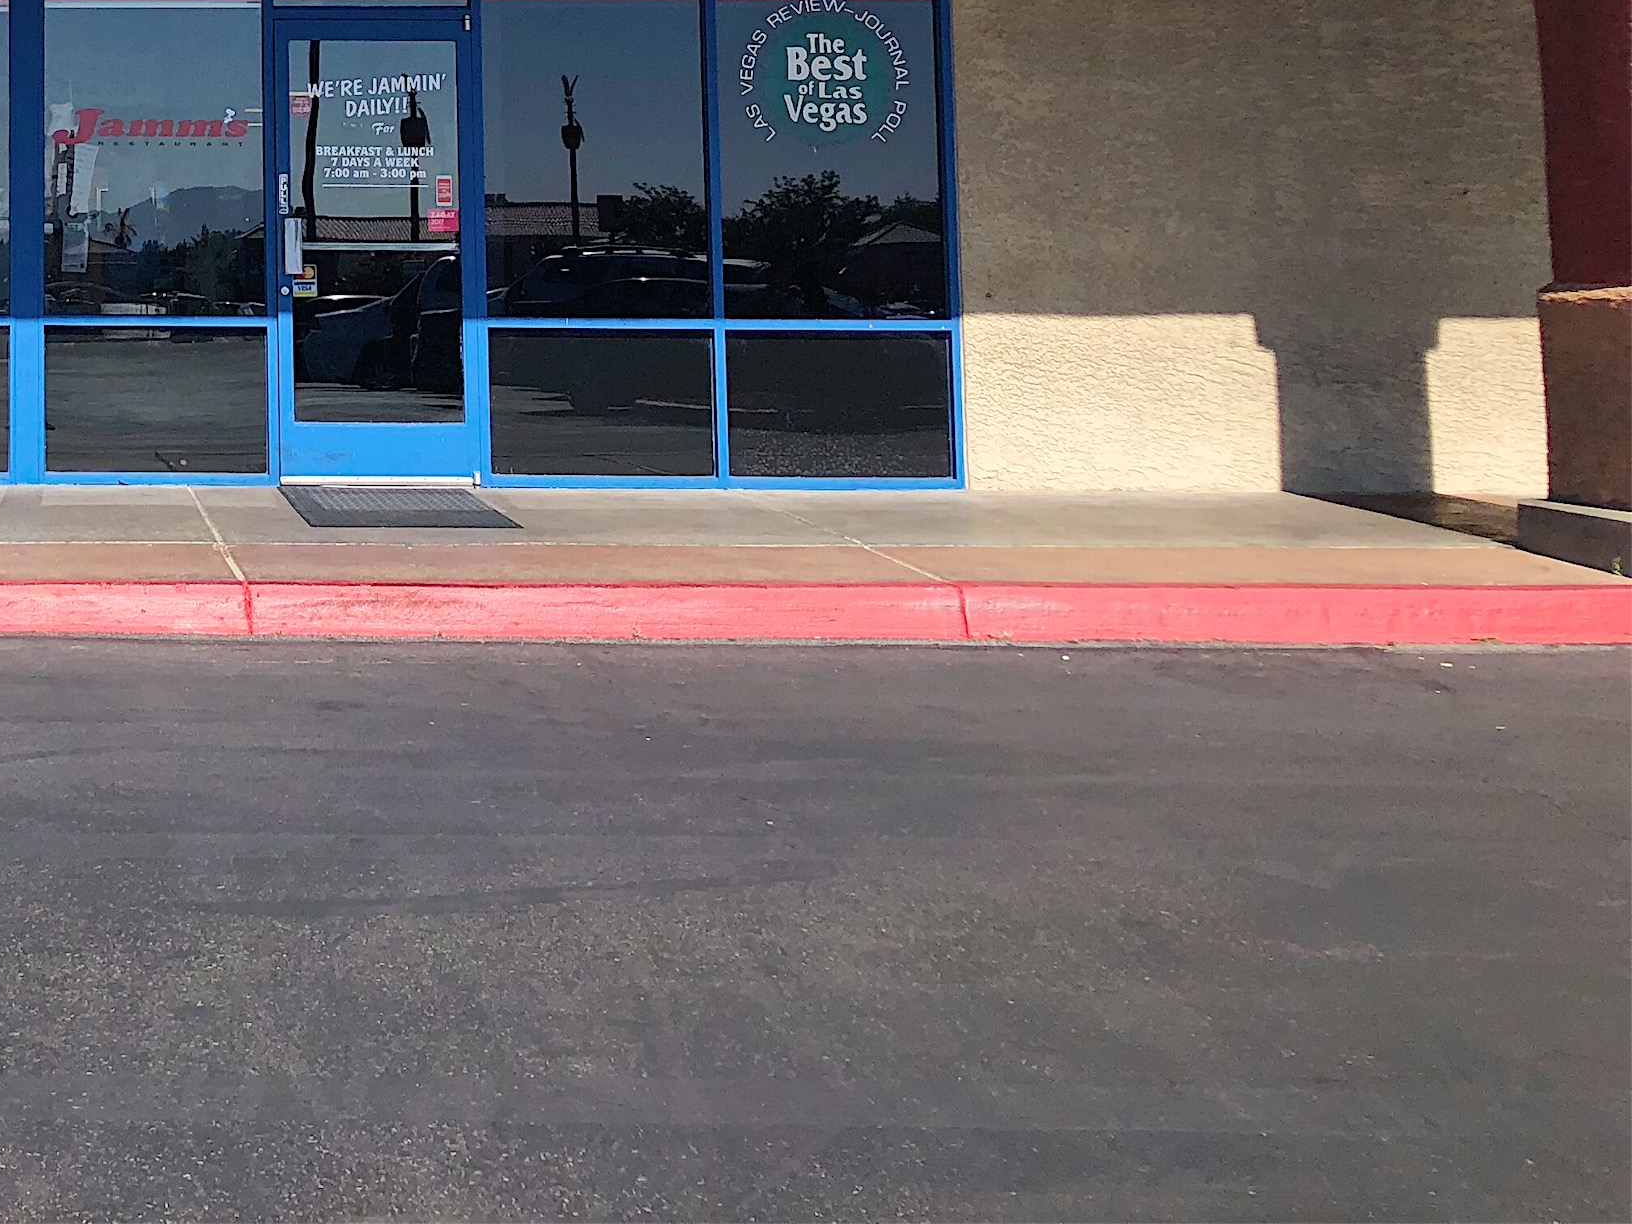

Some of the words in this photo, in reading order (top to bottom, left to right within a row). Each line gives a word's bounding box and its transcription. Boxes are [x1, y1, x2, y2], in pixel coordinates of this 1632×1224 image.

[806, 32, 845, 54] The
[740, 29, 768, 96] VEGAS
[786, 46, 867, 81] Best
[307, 79, 363, 98] WE'RE
[368, 73, 446, 95] JAMMIN'
[798, 81, 815, 96] of
[818, 82, 863, 100] Las
[345, 97, 408, 117] DAILY!!
[783, 94, 868, 132] Vegas
[371, 122, 395, 136] For
[745, 103, 776, 142] LAS
[871, 100, 907, 143] POLL
[316, 146, 382, 156] BREAKFAST
[386, 147, 394, 156] &
[398, 147, 434, 156] LUNCH
[331, 157, 339, 167] 7
[342, 157, 370, 167] DAYS
[374, 157, 382, 167] A
[385, 157, 419, 167] WEEK
[324, 168, 349, 178] 7:00
[353, 170, 370, 178] am
[380, 168, 406, 178] 3:00
[410, 170, 426, 180] pm
